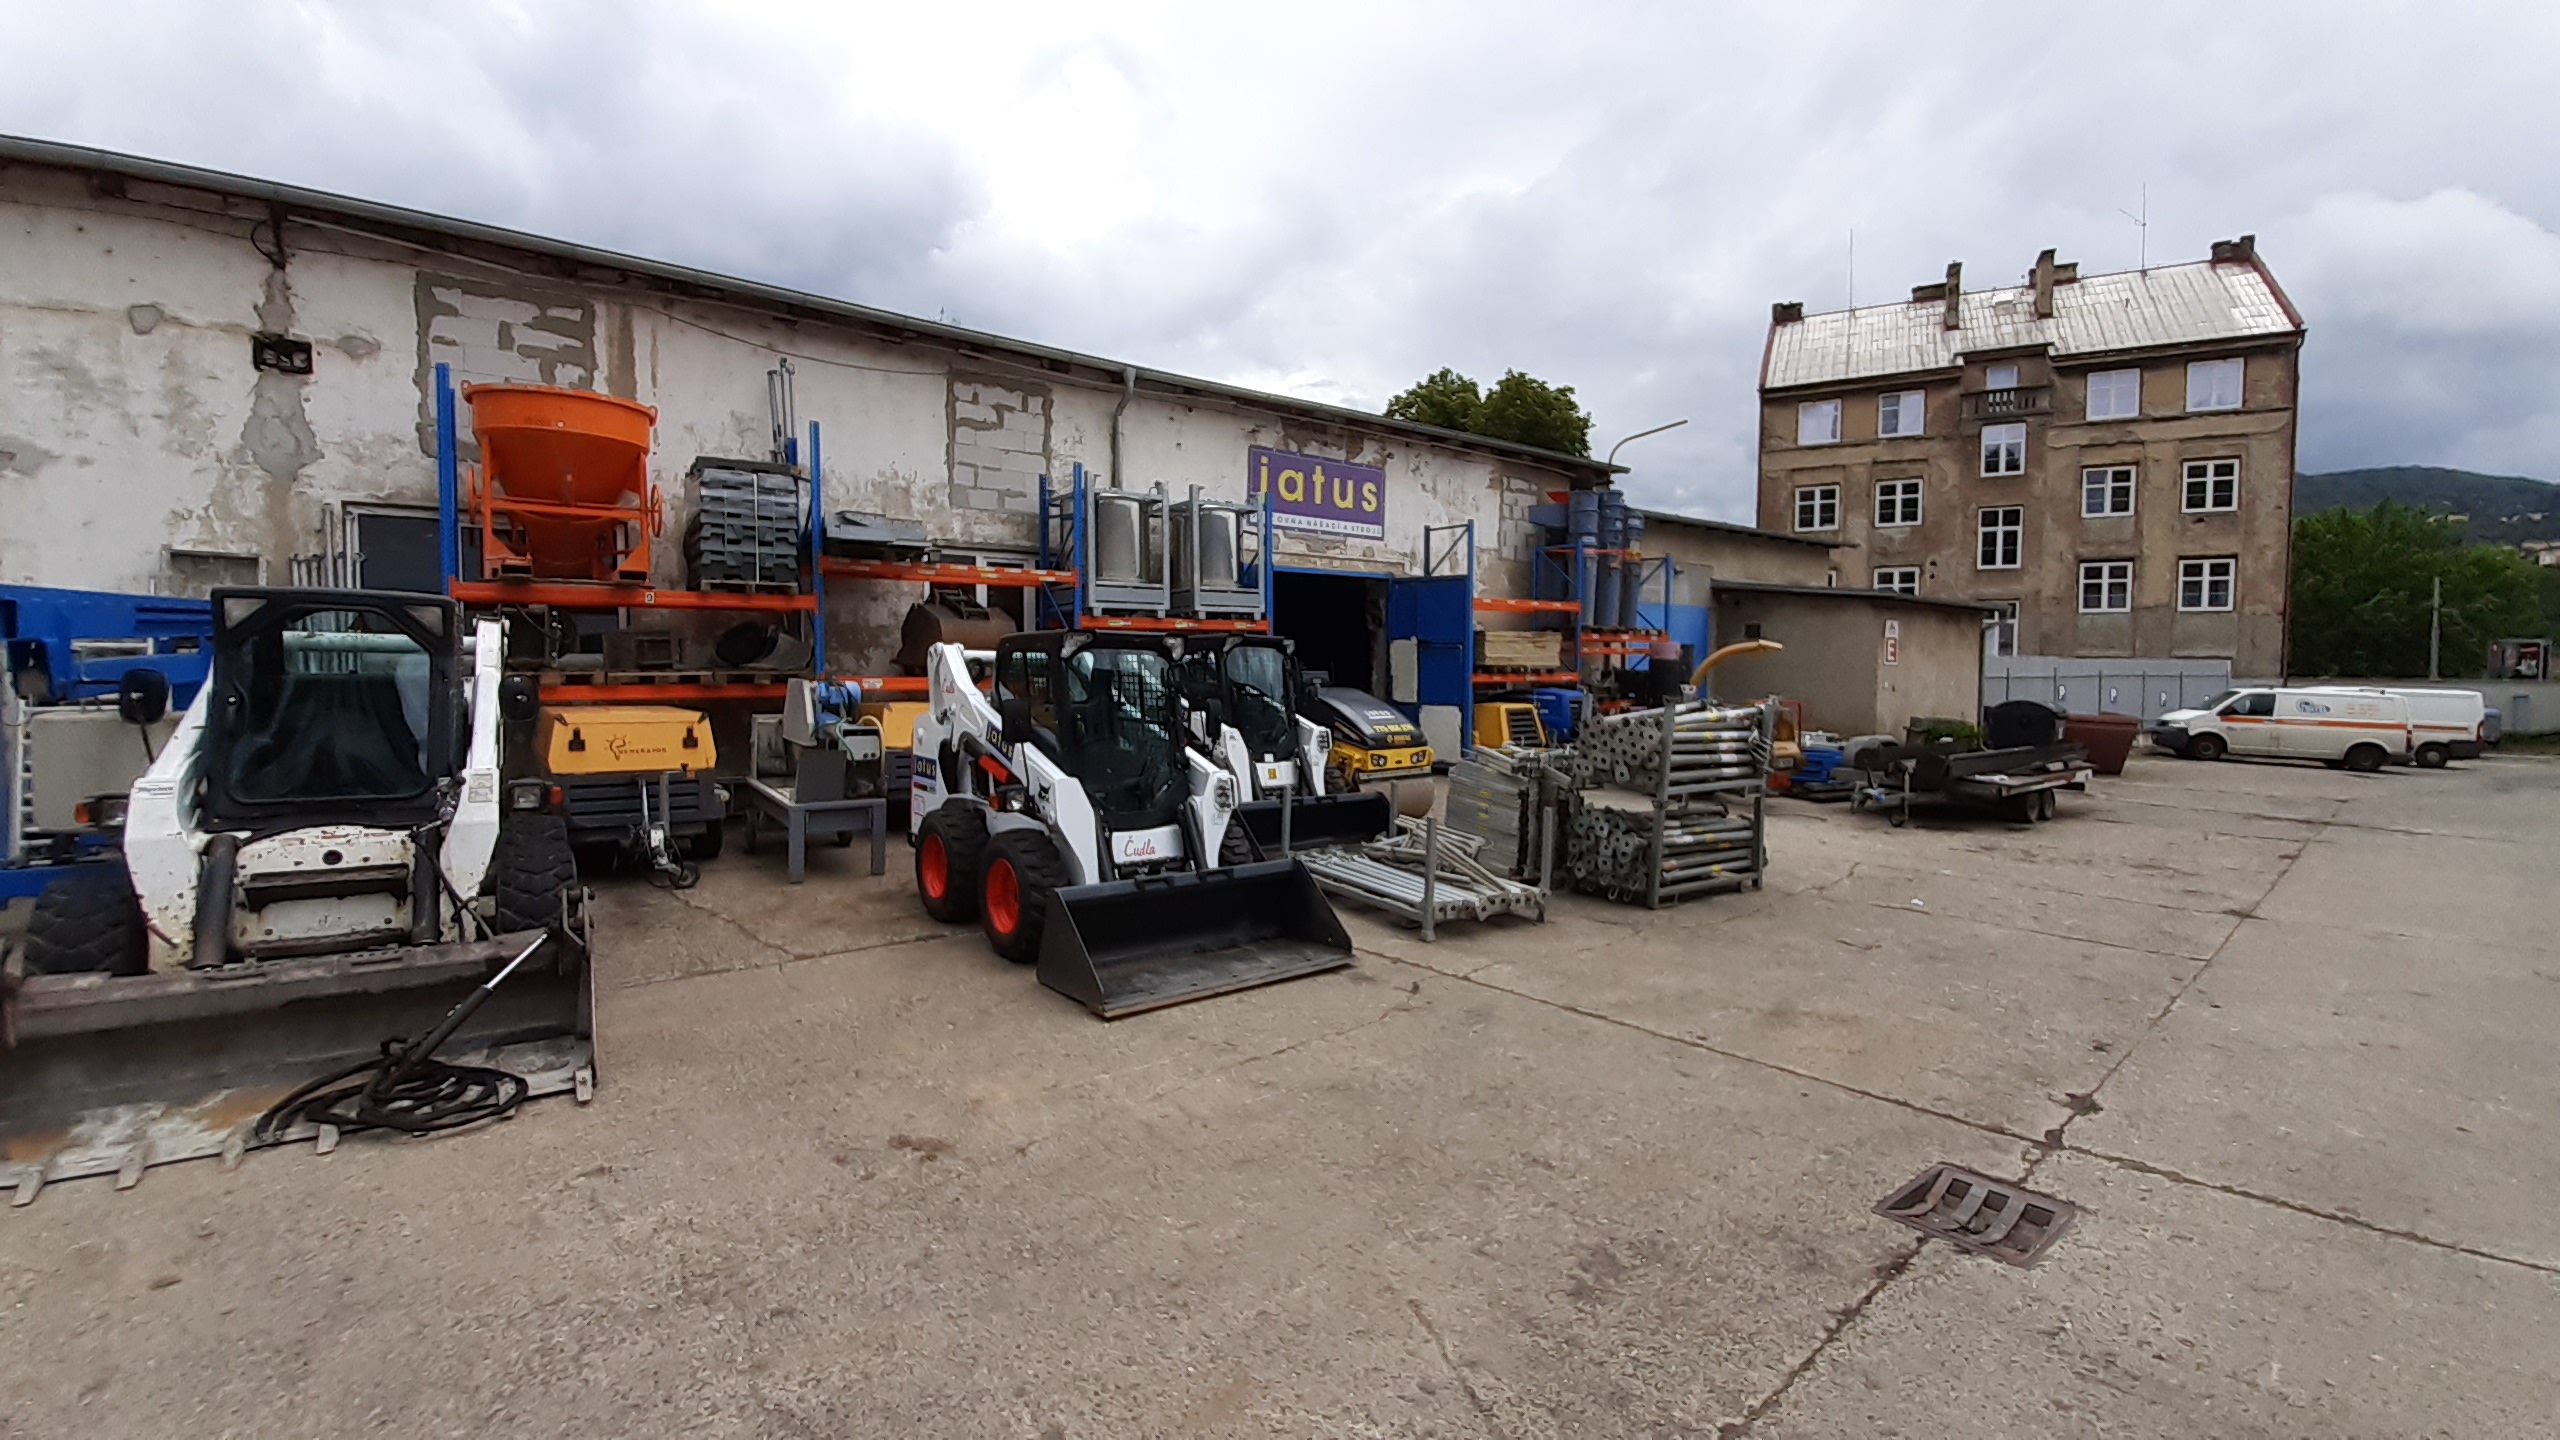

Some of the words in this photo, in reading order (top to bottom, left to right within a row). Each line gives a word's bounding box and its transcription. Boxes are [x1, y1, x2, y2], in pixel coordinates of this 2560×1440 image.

[1887, 639, 1896, 661] E
[2058, 685, 2066, 701] P
[2109, 688, 2117, 703] P
